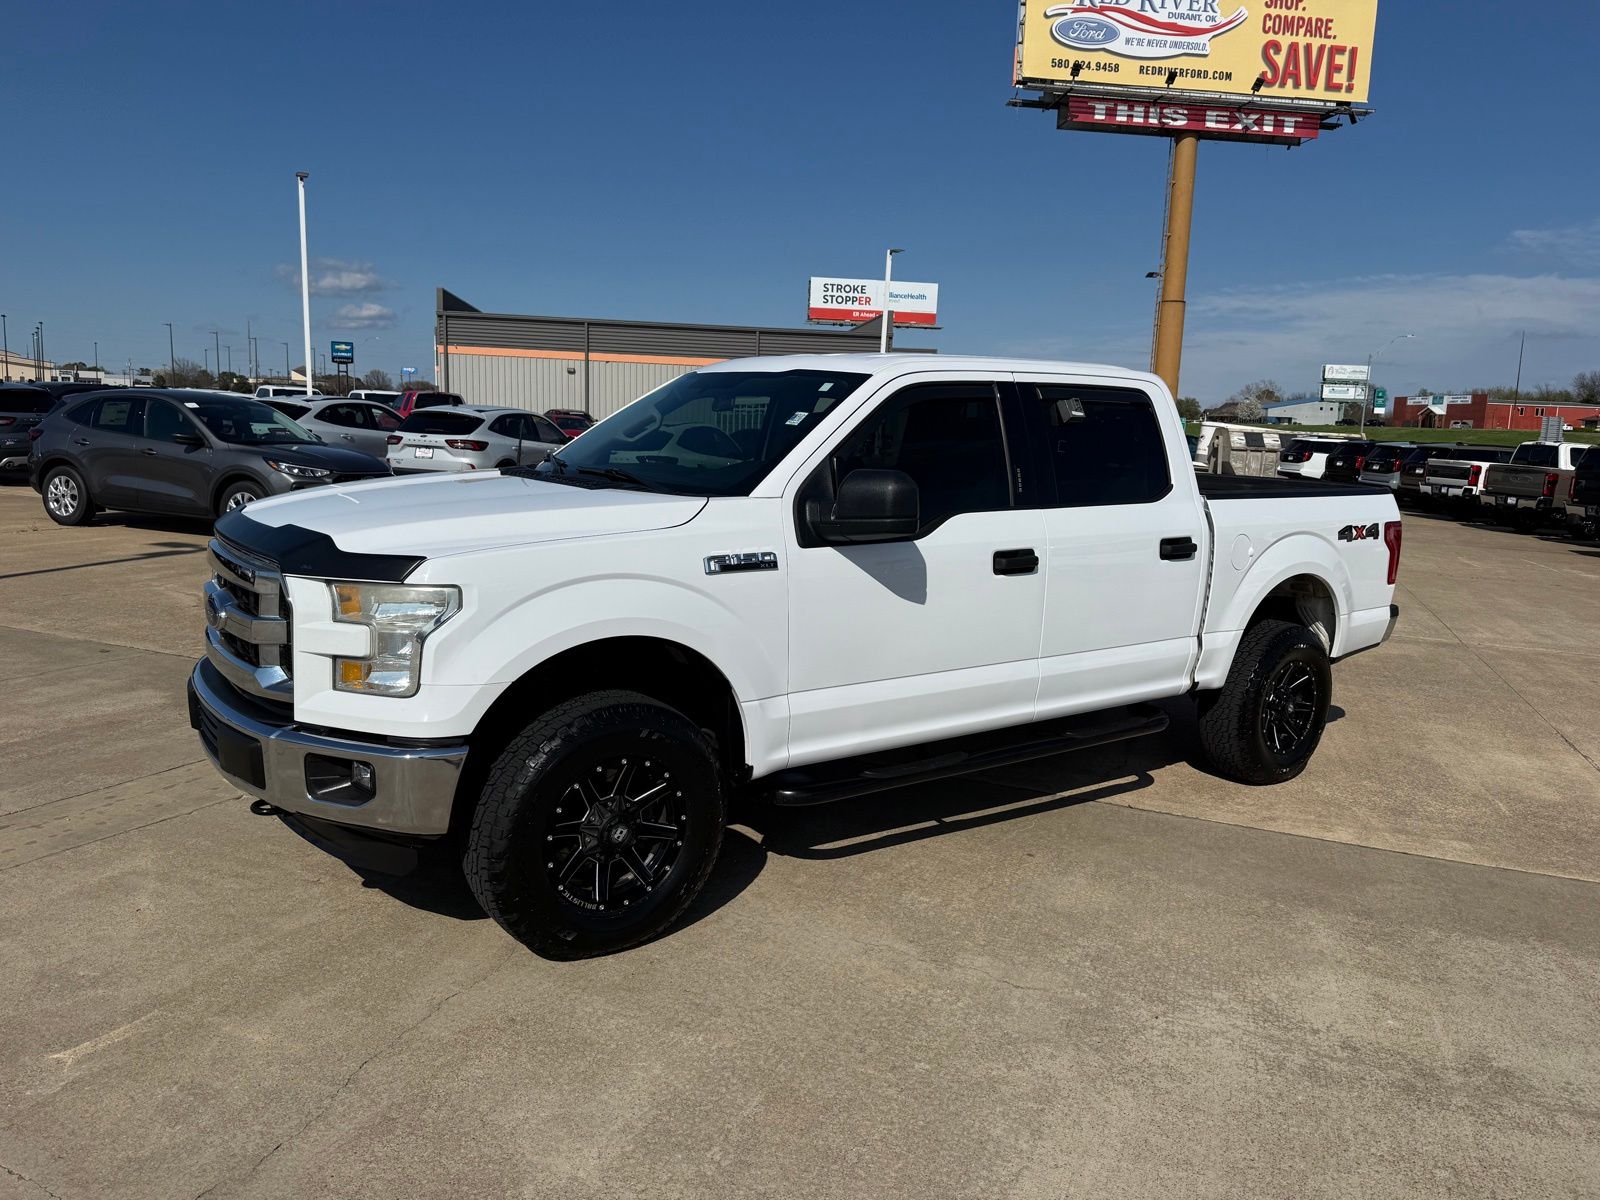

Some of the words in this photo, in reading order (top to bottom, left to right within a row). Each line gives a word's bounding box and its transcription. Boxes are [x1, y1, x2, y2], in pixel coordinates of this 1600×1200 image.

[1168, 11, 1203, 23] DURANT,
[1205, 14, 1217, 23] OK
[1069, 21, 1107, 40] Ford
[1262, 13, 1337, 39] COMPARE.
[1124, 36, 1146, 47] WE'RE
[1147, 38, 1168, 49] NEVER
[1168, 40, 1208, 52] UNDERSOLD.
[1261, 39, 1358, 92] SAVE!
[1088, 102, 1188, 127] THIS
[1205, 110, 1303, 134] EXIT
[823, 283, 867, 294] STROKE
[889, 292, 927, 301] llianceHealth
[822, 294, 872, 306] STOPPER
